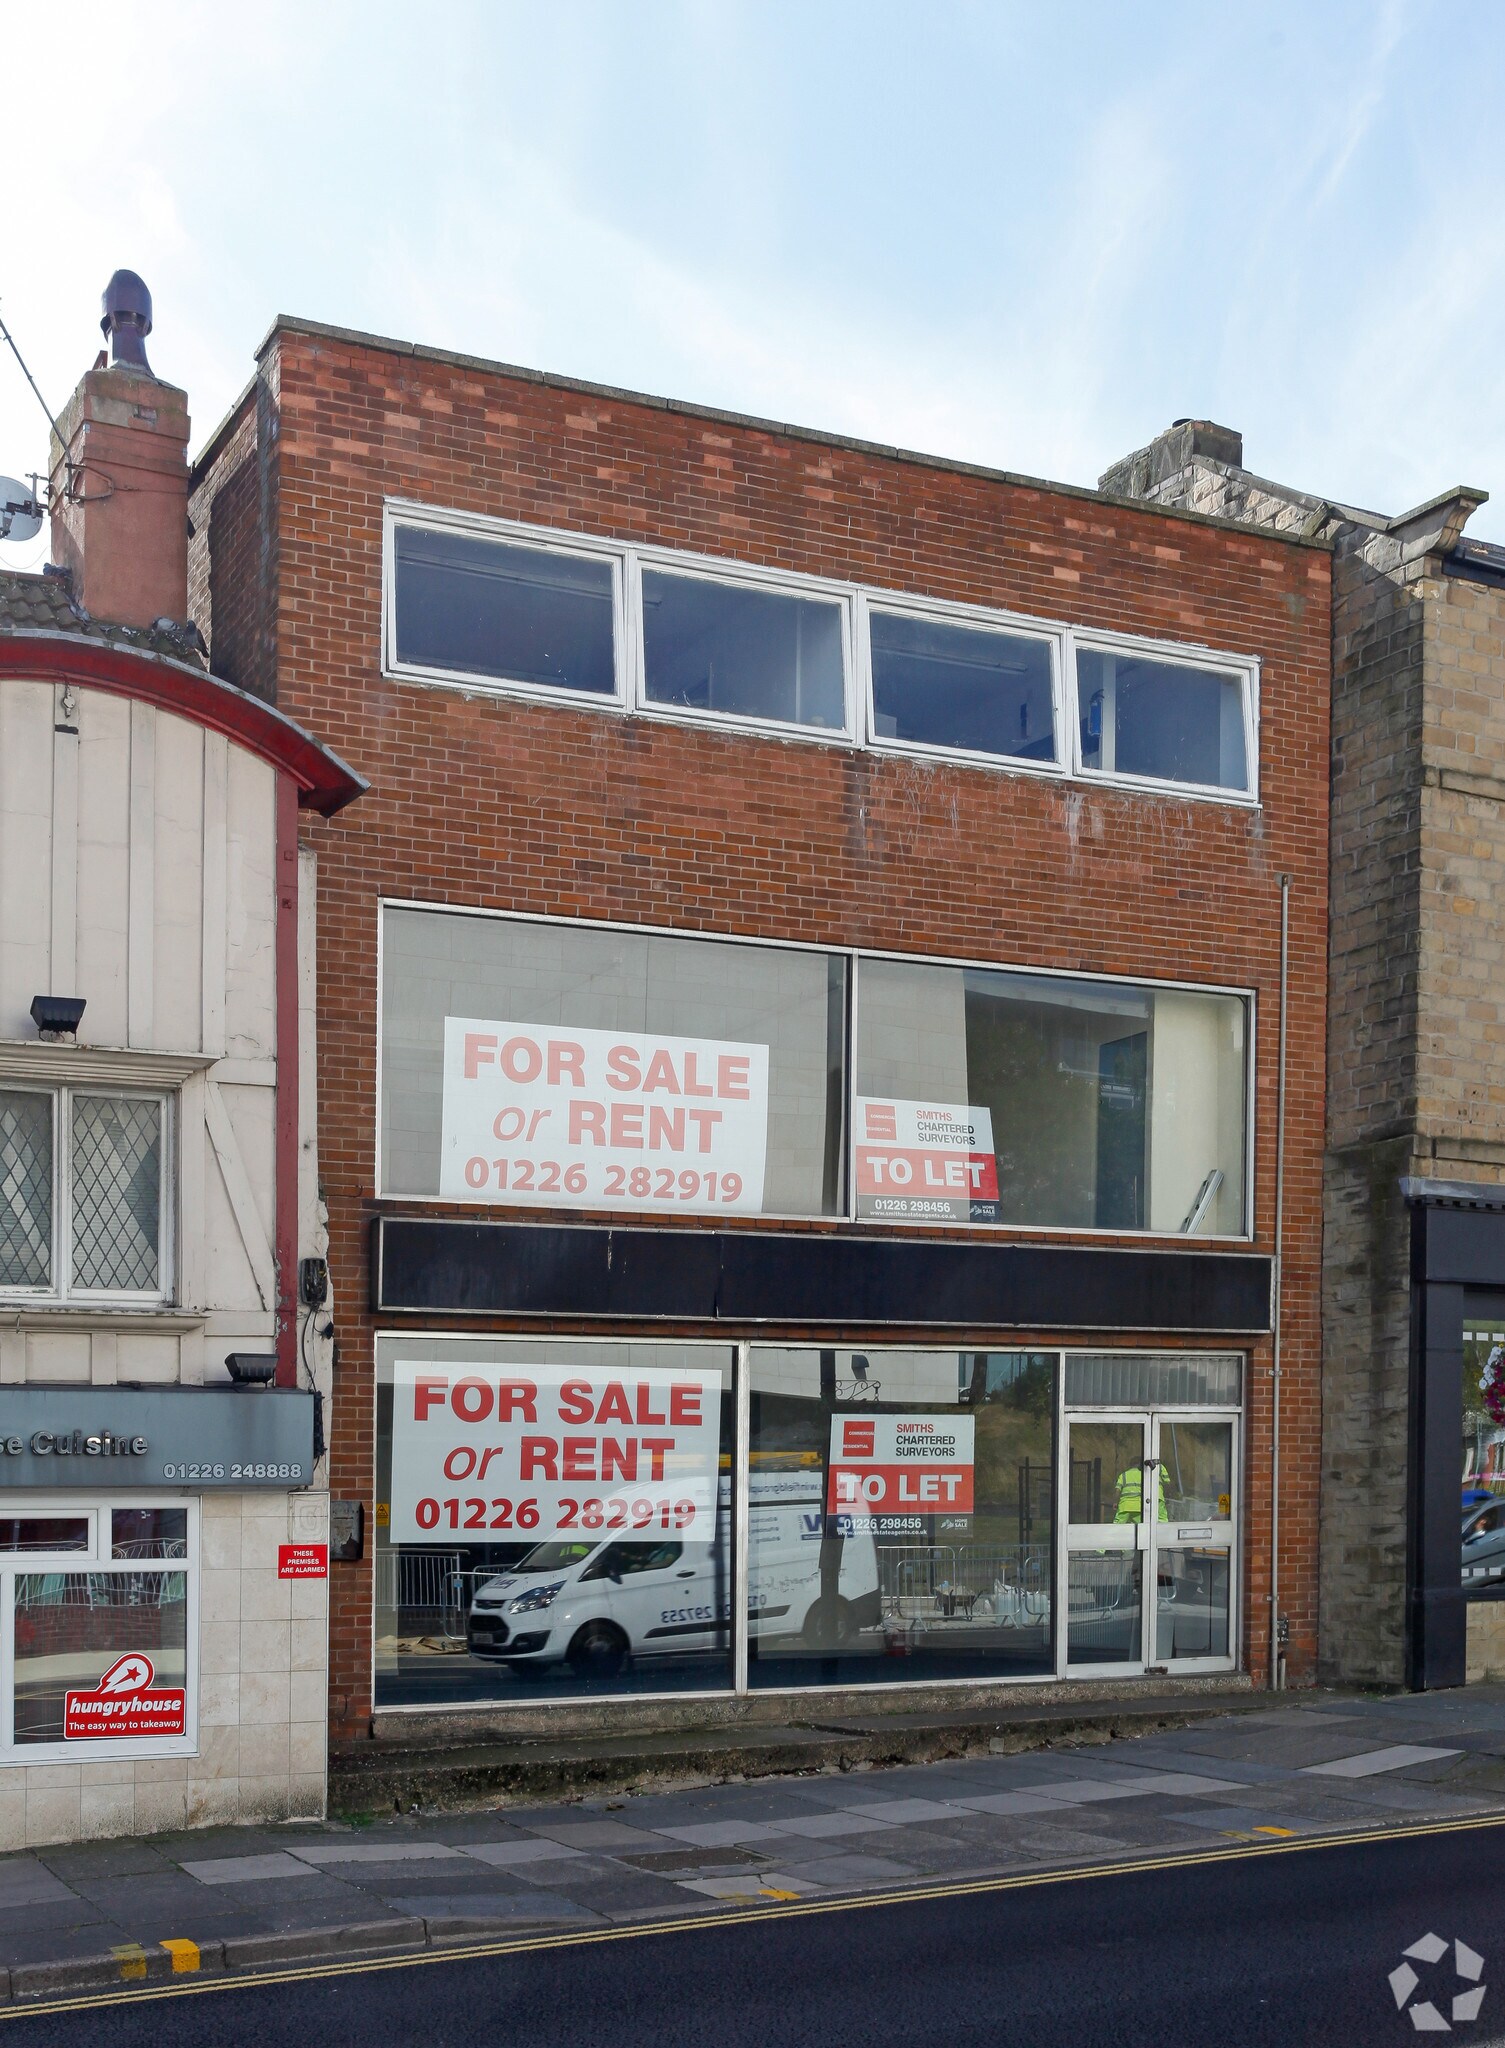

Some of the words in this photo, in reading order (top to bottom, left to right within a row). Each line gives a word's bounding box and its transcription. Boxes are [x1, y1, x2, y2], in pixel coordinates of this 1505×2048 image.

[464, 1033, 585, 1087] FOR
[606, 1045, 750, 1100] SALE
[916, 1110, 953, 1121] SMITHS
[492, 1107, 552, 1142] or
[568, 1100, 723, 1153] RENT
[917, 1122, 974, 1134] CHARTERED
[918, 1133, 976, 1145] SURVEYORS
[464, 1156, 588, 1194] 01226
[603, 1165, 743, 1203] 282919
[866, 1156, 913, 1184] TO
[924, 1159, 985, 1188] LET
[875, 1199, 907, 1211] 01226
[910, 1201, 951, 1213] 298456
[414, 1375, 538, 1423] FOR
[557, 1378, 703, 1426] SALE
[896, 1424, 934, 1433] SMITHS
[31, 1430, 148, 1456] Cuisine
[896, 1436, 955, 1445] CHARTERED
[443, 1446, 503, 1481] or
[519, 1435, 675, 1482] RENT
[896, 1447, 955, 1457] SURVEYORS
[163, 1463, 225, 1479] 01226
[230, 1463, 302, 1479] 248888
[840, 1474, 887, 1502] TO
[899, 1474, 962, 1502] LET
[415, 1497, 540, 1530] 01226
[556, 1497, 696, 1530] 282919
[843, 1518, 877, 1529] 01226
[880, 1518, 922, 1529] 298456
[69, 1696, 182, 1717] hungryhouse
[68, 1722, 85, 1730] The
[87, 1722, 107, 1731] easy
[109, 1722, 127, 1730] way
[129, 1720, 138, 1728] to
[140, 1719, 181, 1729] takeaway
